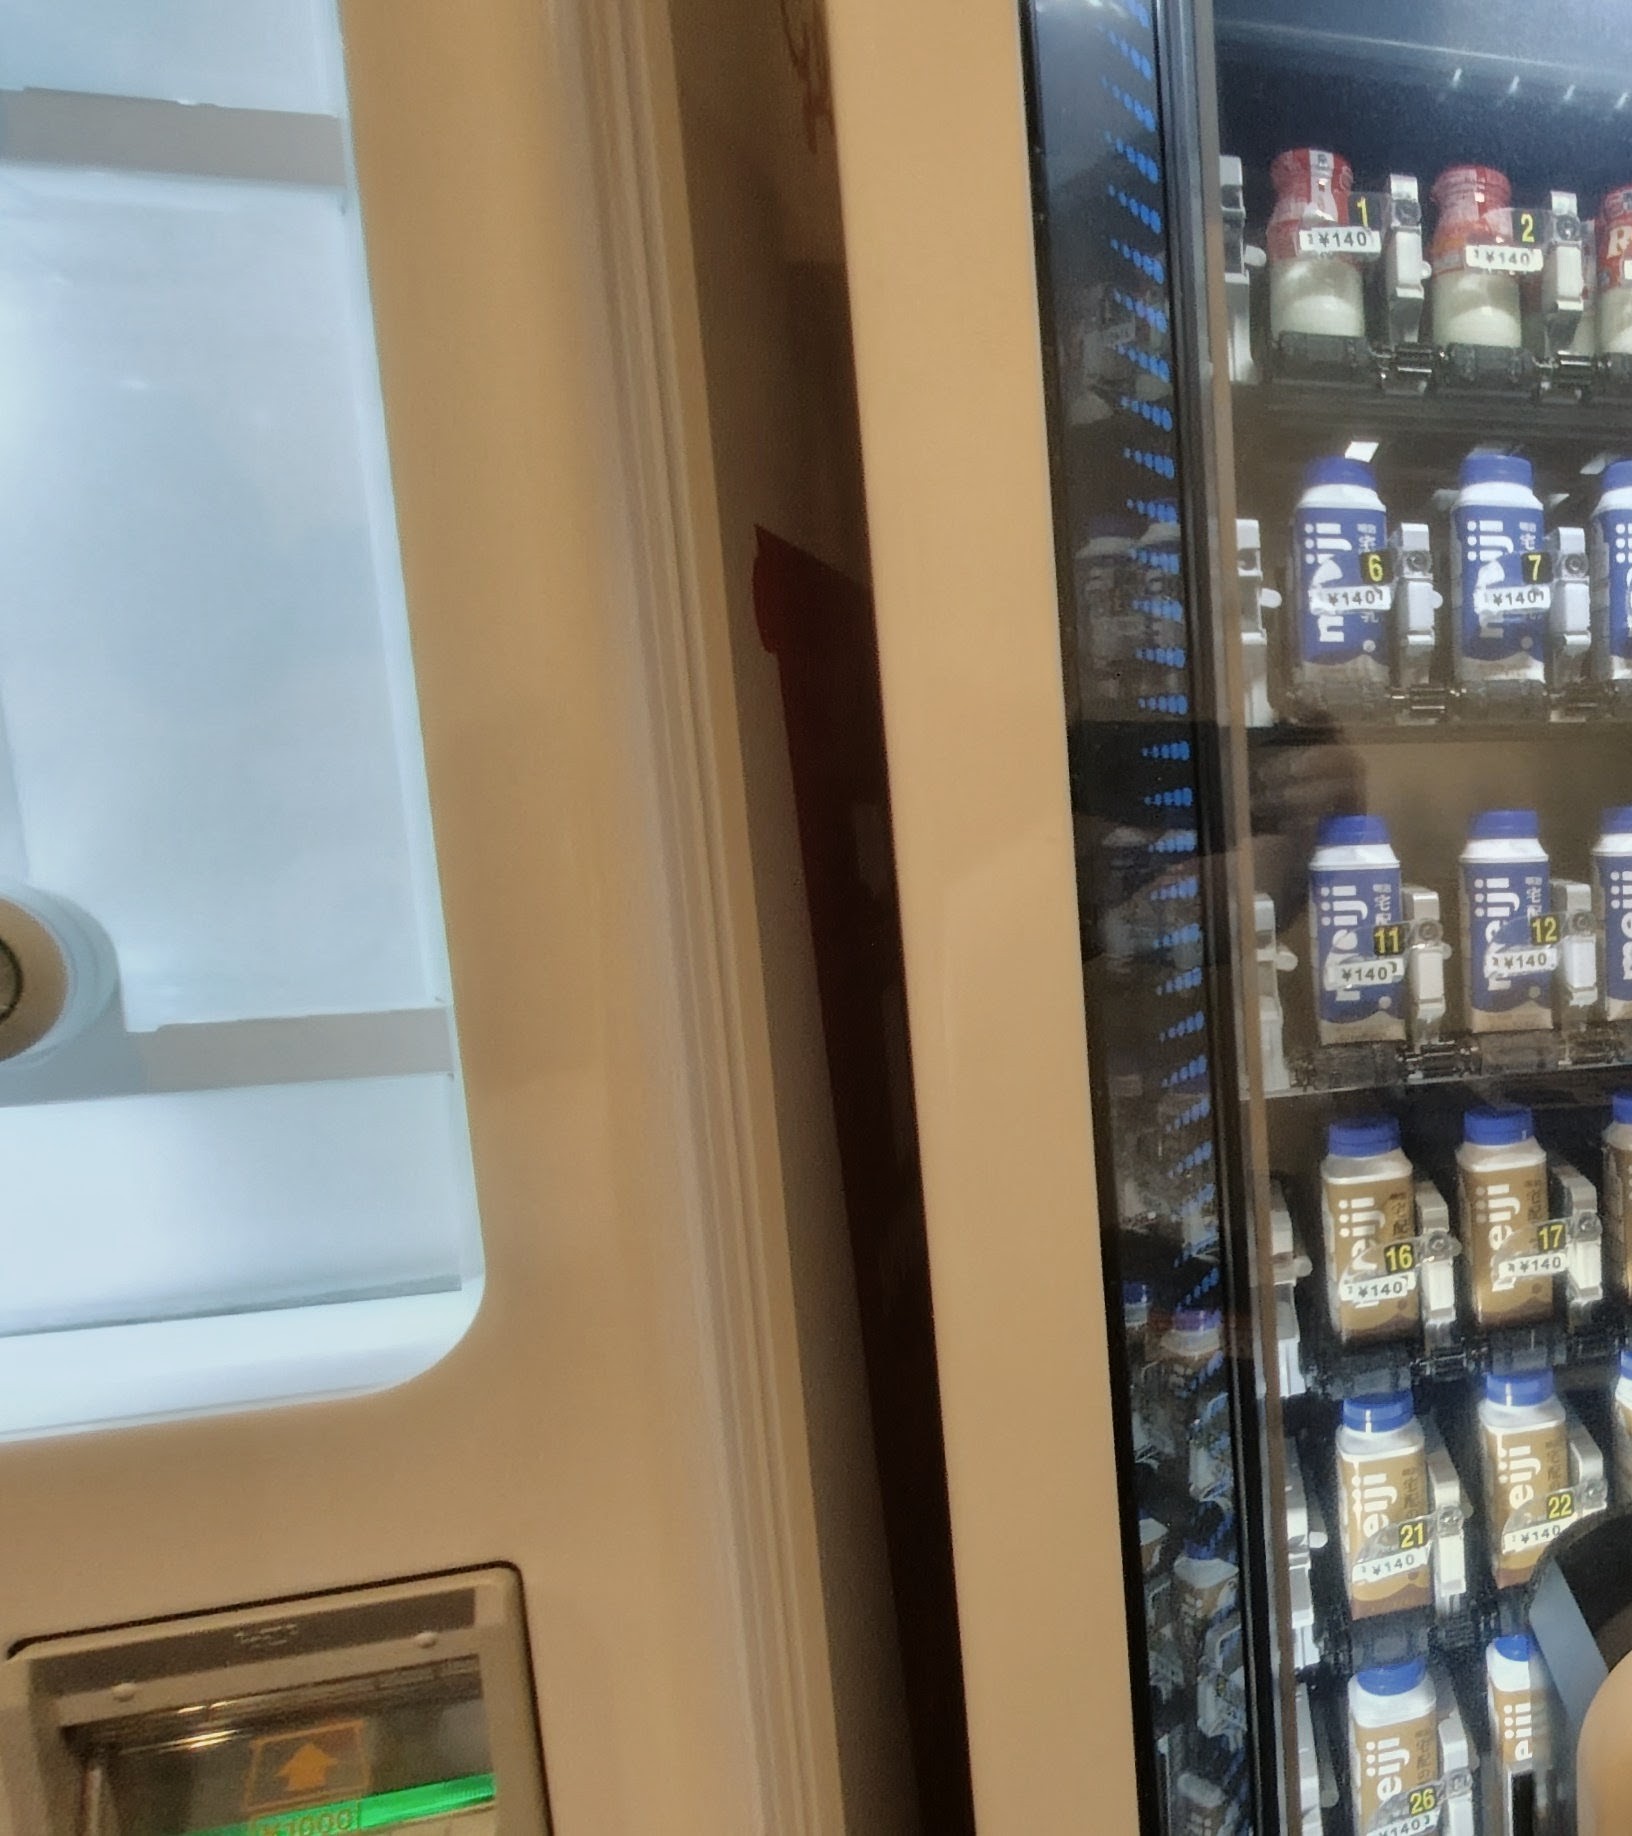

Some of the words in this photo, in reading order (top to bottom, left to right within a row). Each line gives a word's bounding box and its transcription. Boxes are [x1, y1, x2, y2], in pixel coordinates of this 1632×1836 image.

[1356, 196, 1369, 228] 1
[1520, 213, 1535, 243] 2
[1367, 553, 1385, 583] 6
[1527, 553, 1542, 582] 7
[1374, 927, 1401, 955] 11
[1531, 916, 1558, 945] 12
[1538, 1225, 1564, 1251] 17
[1386, 1244, 1413, 1272] 16
[1548, 1494, 1573, 1519] 22
[1400, 1523, 1425, 1549] 21
[1410, 1788, 1435, 1815] 26
